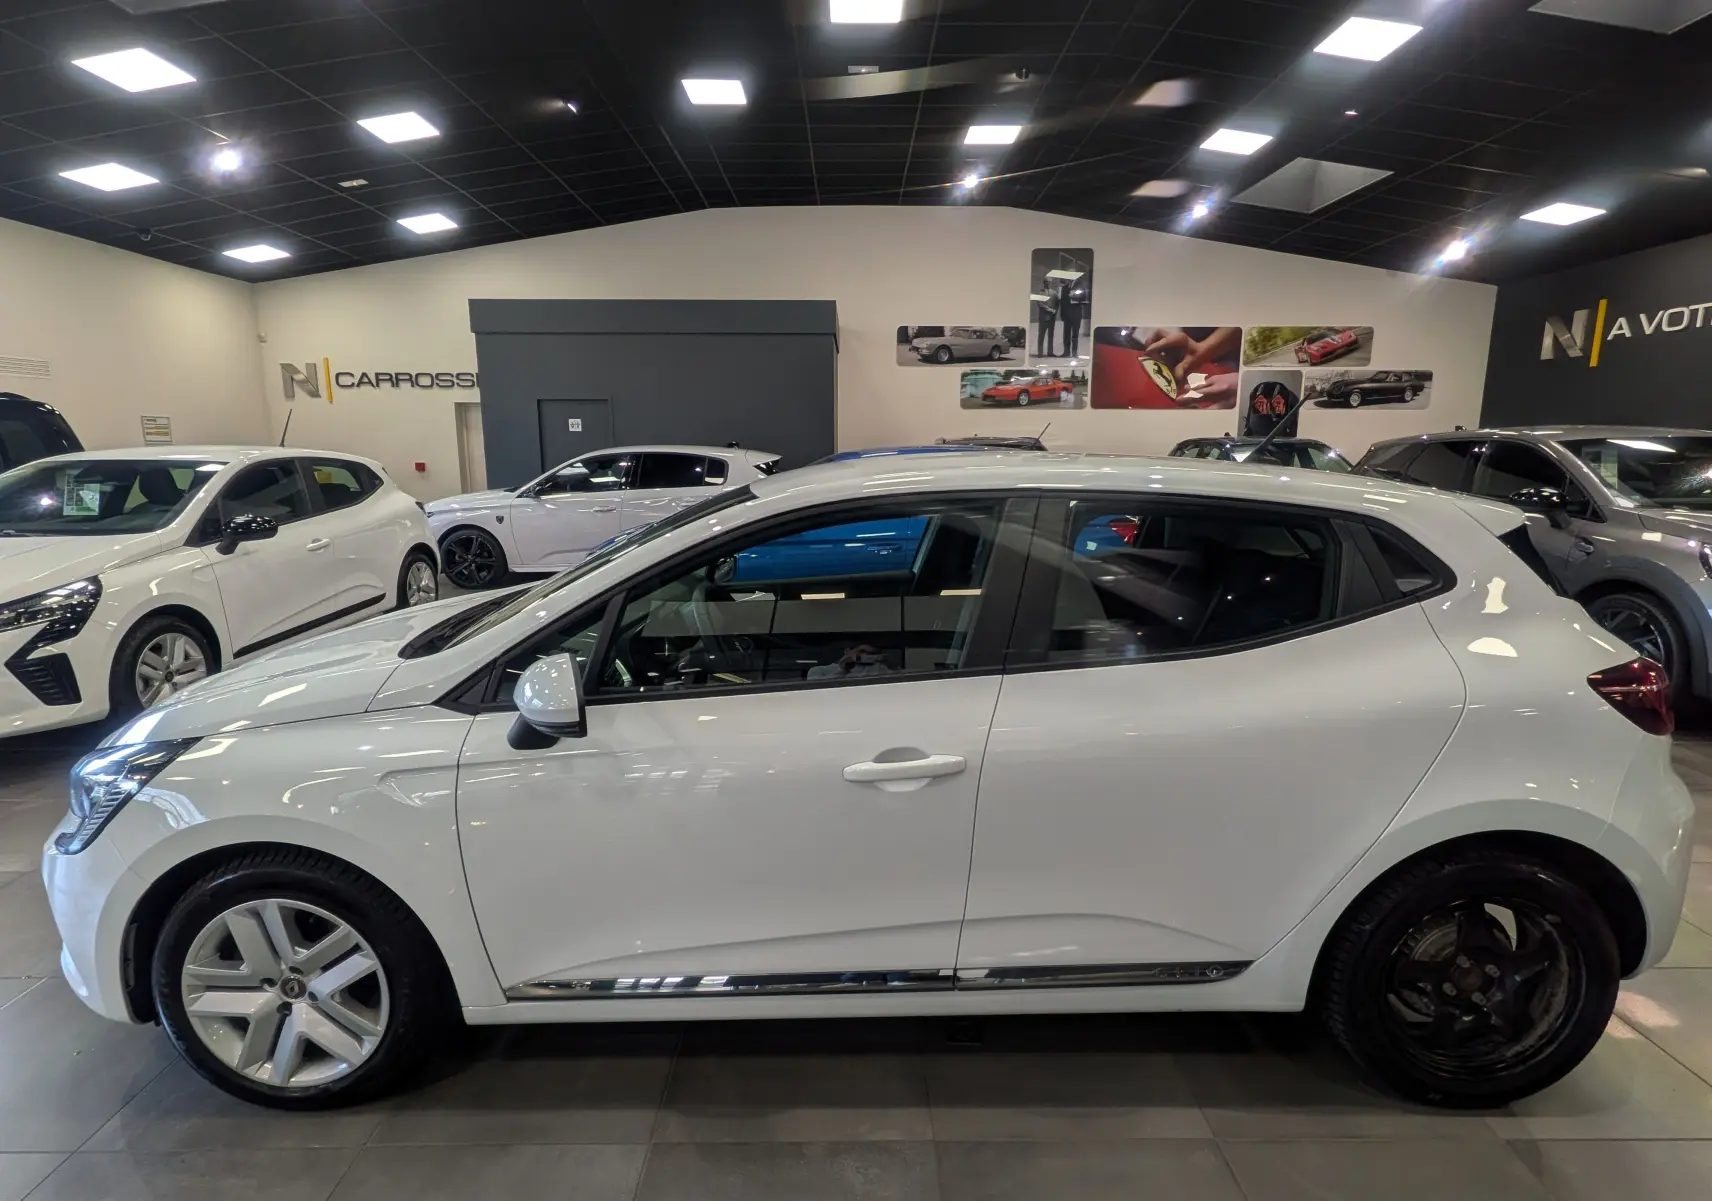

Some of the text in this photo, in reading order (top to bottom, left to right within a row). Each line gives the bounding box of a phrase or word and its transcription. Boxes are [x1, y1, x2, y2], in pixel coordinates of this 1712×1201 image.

[1540, 302, 1712, 360] N A VOT
[280, 362, 321, 399] N
